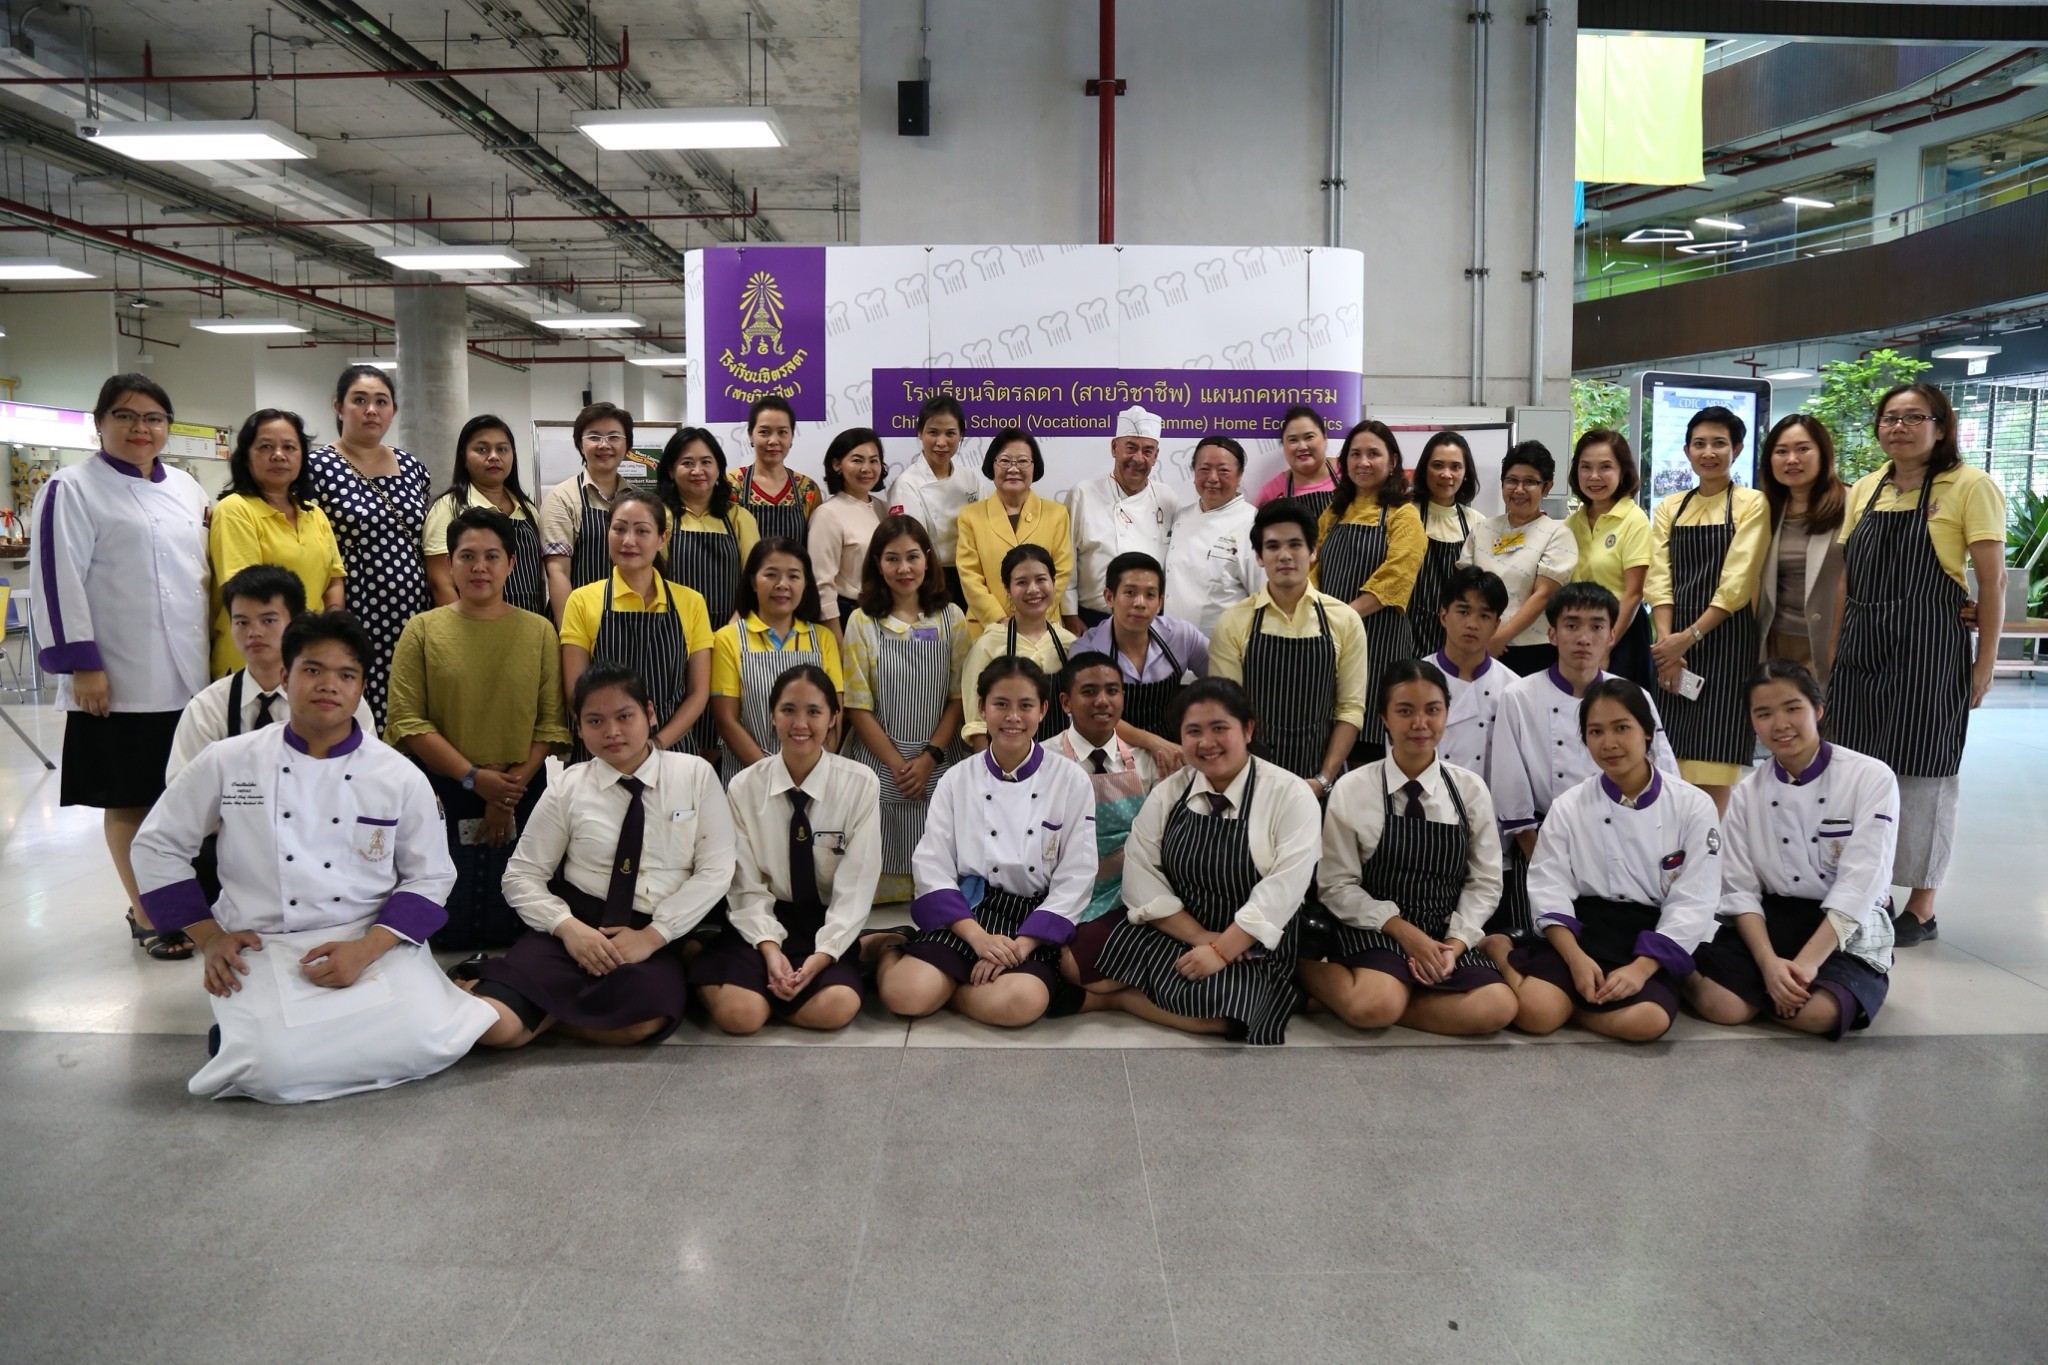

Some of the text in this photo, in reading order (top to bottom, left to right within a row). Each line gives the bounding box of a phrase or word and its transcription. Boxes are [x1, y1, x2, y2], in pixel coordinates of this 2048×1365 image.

[719, 348, 808, 384] โรงเรียนจิตรลดา
[725, 381, 802, 403] (สายวิชีพ)
[1071, 380, 1191, 407] (สายวิชาชีพ)
[1200, 387, 1338, 404] แผนกคหกรรม
[970, 414, 1021, 429] School
[1027, 414, 1111, 431] (Vocational
[1160, 416, 1208, 433] amme)
[1213, 416, 1258, 430] Home
[1262, 416, 1343, 430] Ecics
